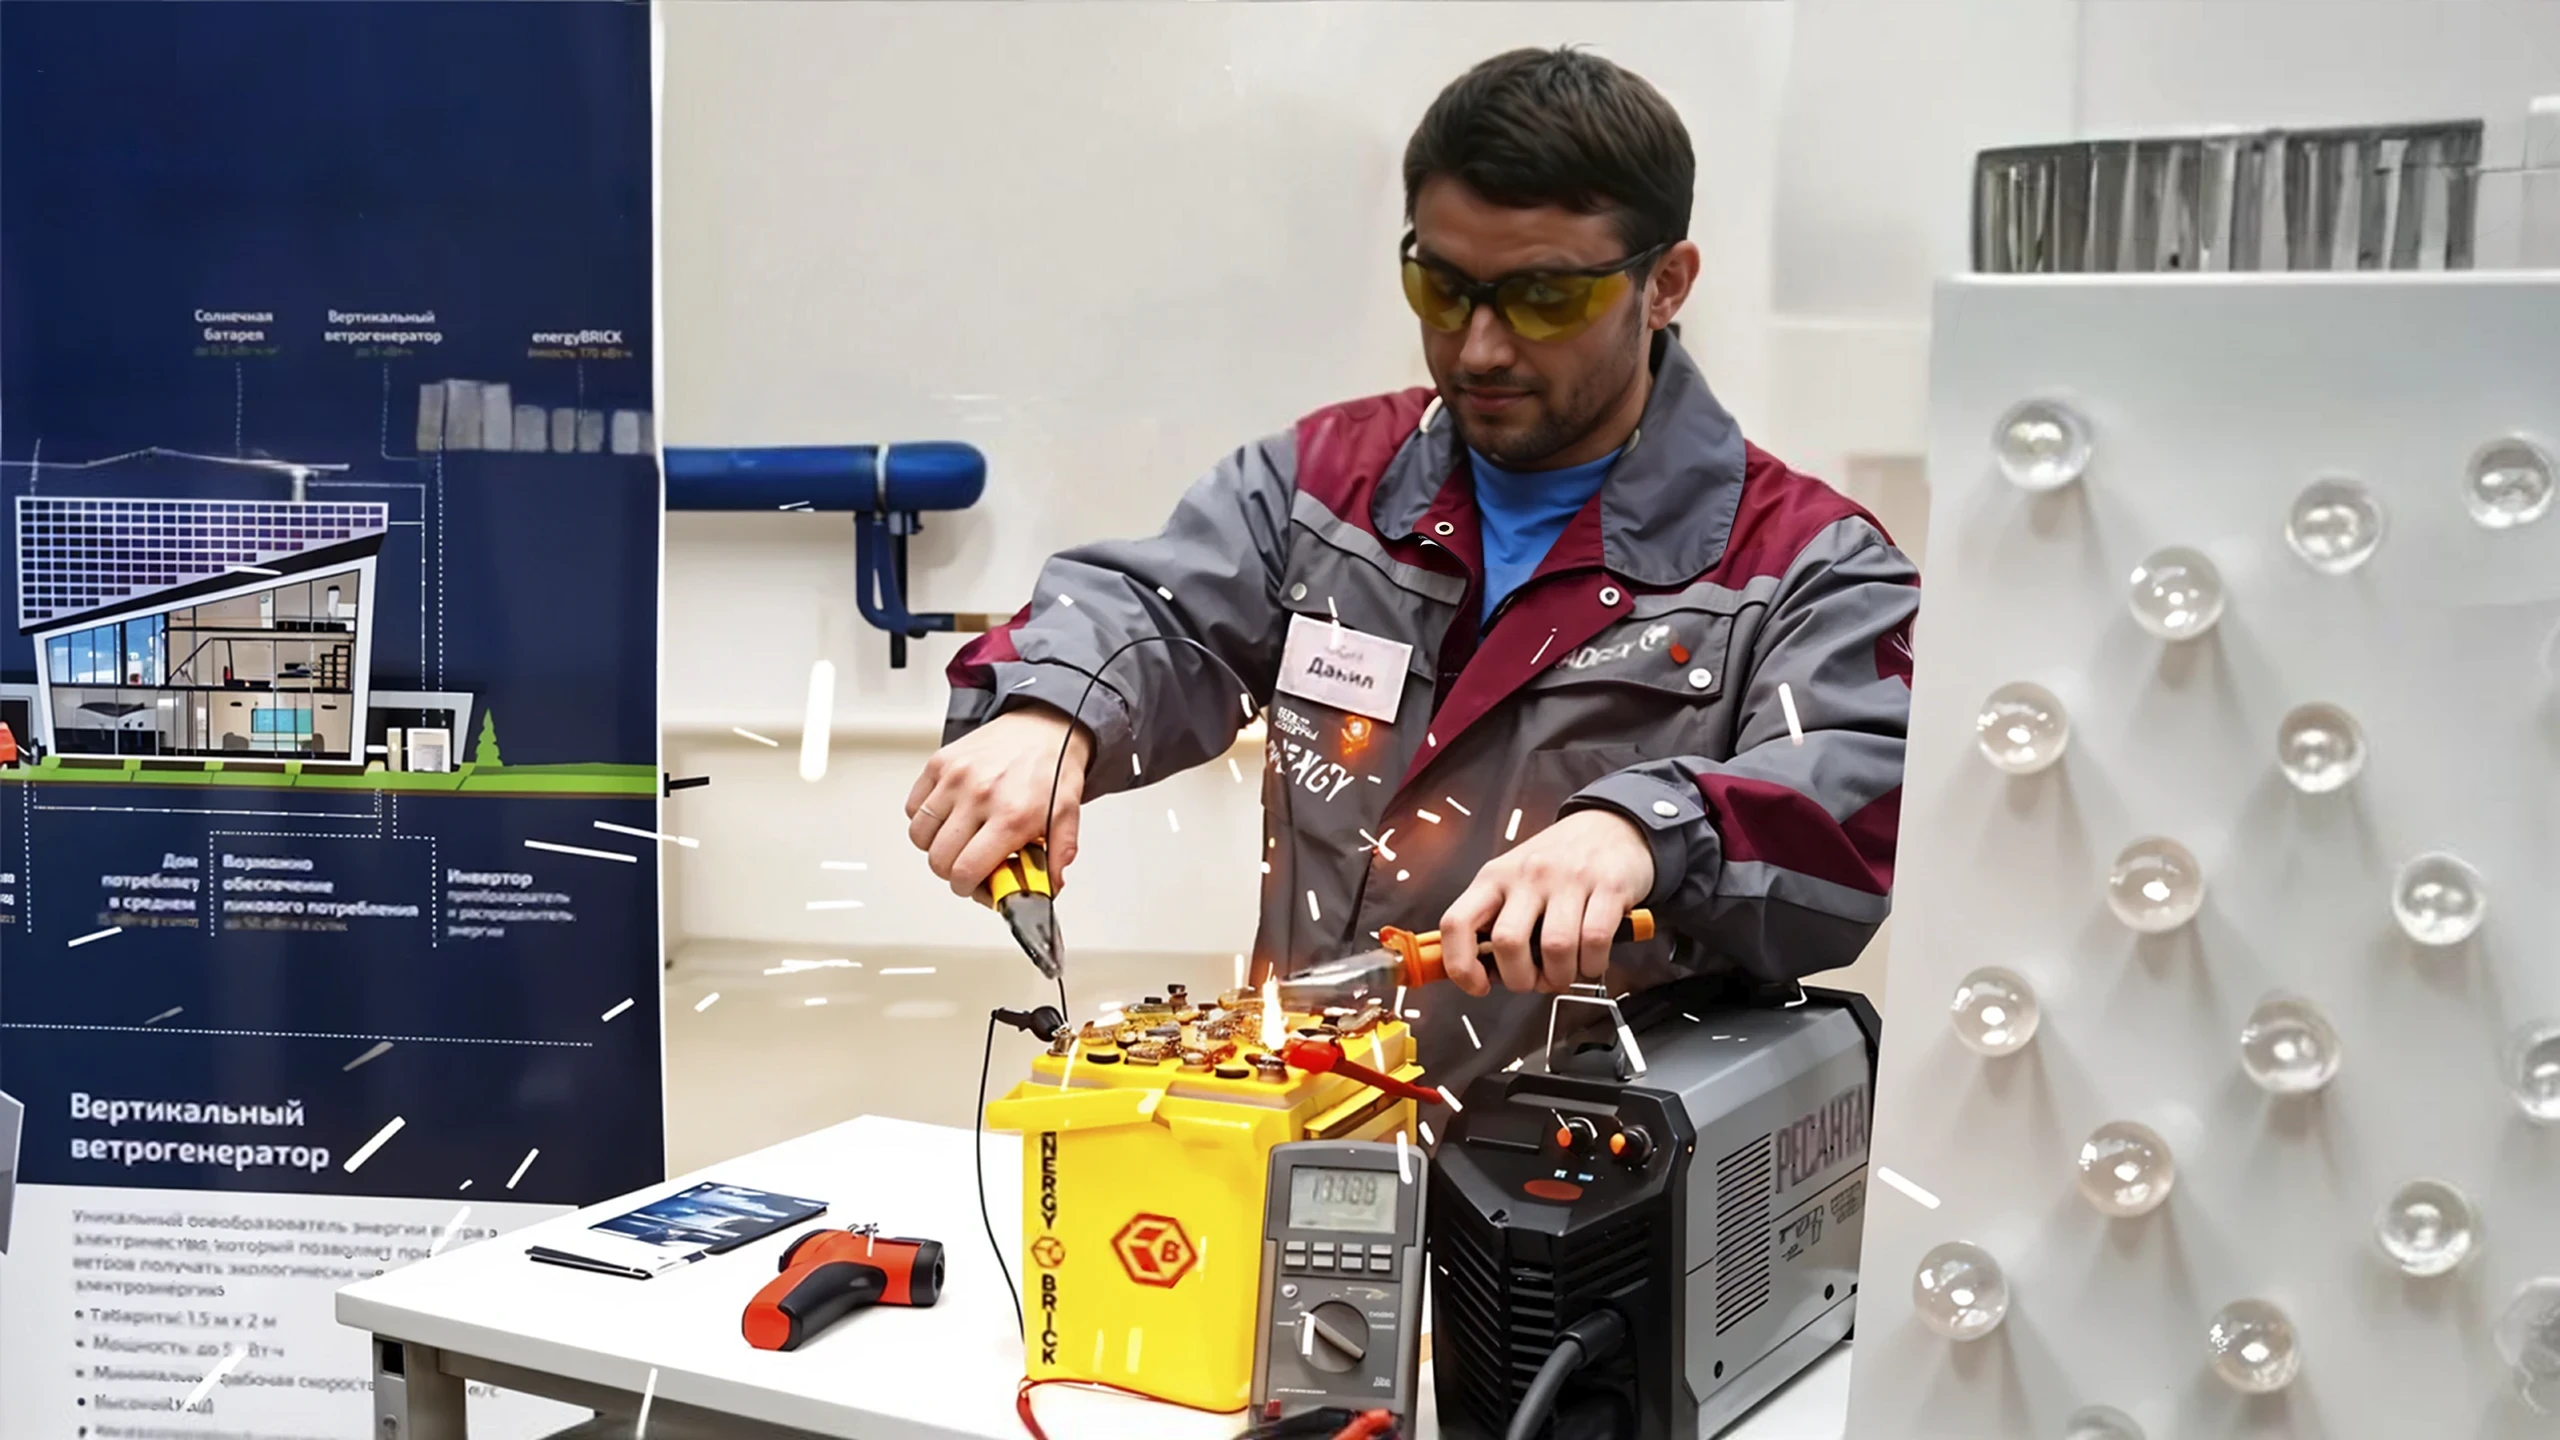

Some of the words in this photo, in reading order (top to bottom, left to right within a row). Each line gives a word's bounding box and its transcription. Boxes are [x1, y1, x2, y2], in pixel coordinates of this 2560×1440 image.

[194, 309, 274, 323] Солнечная
[328, 309, 436, 325] Вертикальный
[204, 328, 264, 342] батарея
[324, 331, 443, 346] ветрогенератор
[532, 329, 623, 346] energyBRICK
[1306, 656, 1374, 690] Данил
[162, 853, 199, 869] Дом
[222, 854, 313, 871] Возможно
[102, 873, 200, 892] потребляет
[222, 877, 334, 894] обеспечение
[448, 869, 533, 888] Инвертор
[123, 898, 196, 913] среднем
[223, 900, 304, 914] пикового
[308, 901, 419, 918] потребления
[71, 1092, 304, 1126] Вертикальный
[71, 1139, 330, 1172] ветрогенератор
[1042, 1274, 1057, 1365] BRICK
